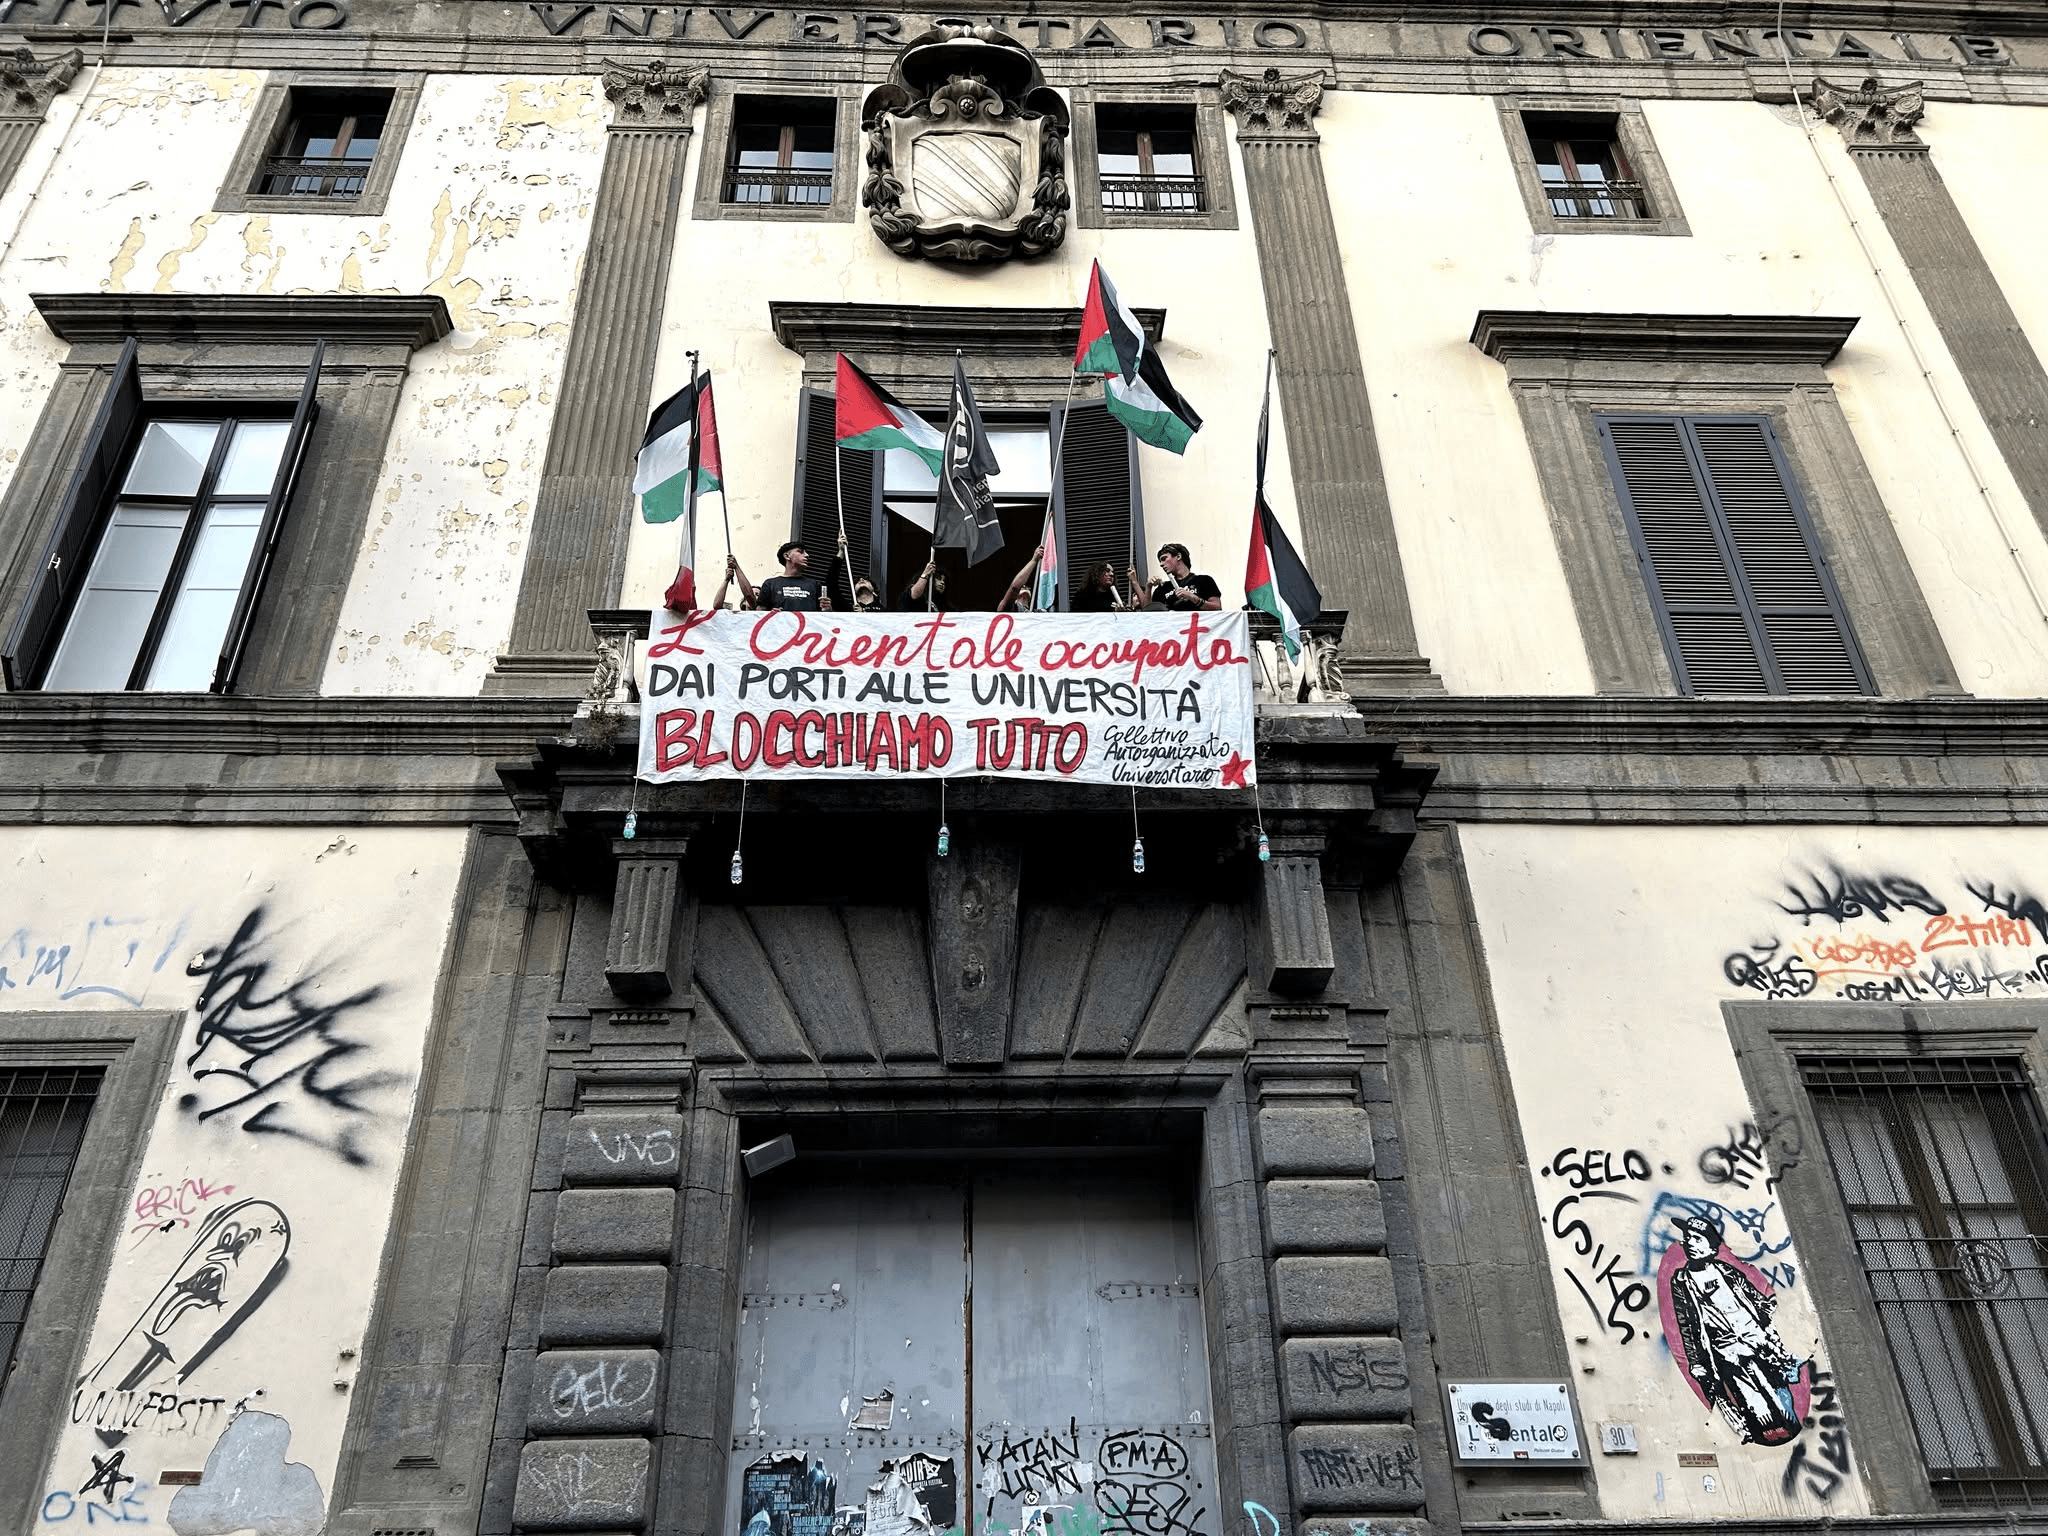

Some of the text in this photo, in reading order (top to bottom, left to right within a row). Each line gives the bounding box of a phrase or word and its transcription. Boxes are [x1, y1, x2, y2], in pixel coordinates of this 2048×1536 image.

[1467, 27, 2011, 65] ORIENTALE
[750, 611, 1024, 672] Orientale
[1040, 612, 1248, 685] occupata
[649, 663, 715, 697] DAI
[856, 671, 951, 704] ALLE
[972, 672, 1201, 723] UNIVERSITÀ
[656, 709, 1089, 774] BLOCCHIAMO TUTTO
[1103, 725, 1189, 745] Collettivo
[1112, 762, 1220, 785] Universitario
[72, 1389, 250, 1438] UNIVERSIT
[1496, 1399, 1512, 1414] degli
[1515, 1399, 1532, 1412] studi
[1534, 1399, 1542, 1412] di
[1543, 1399, 1566, 1414] Napoli
